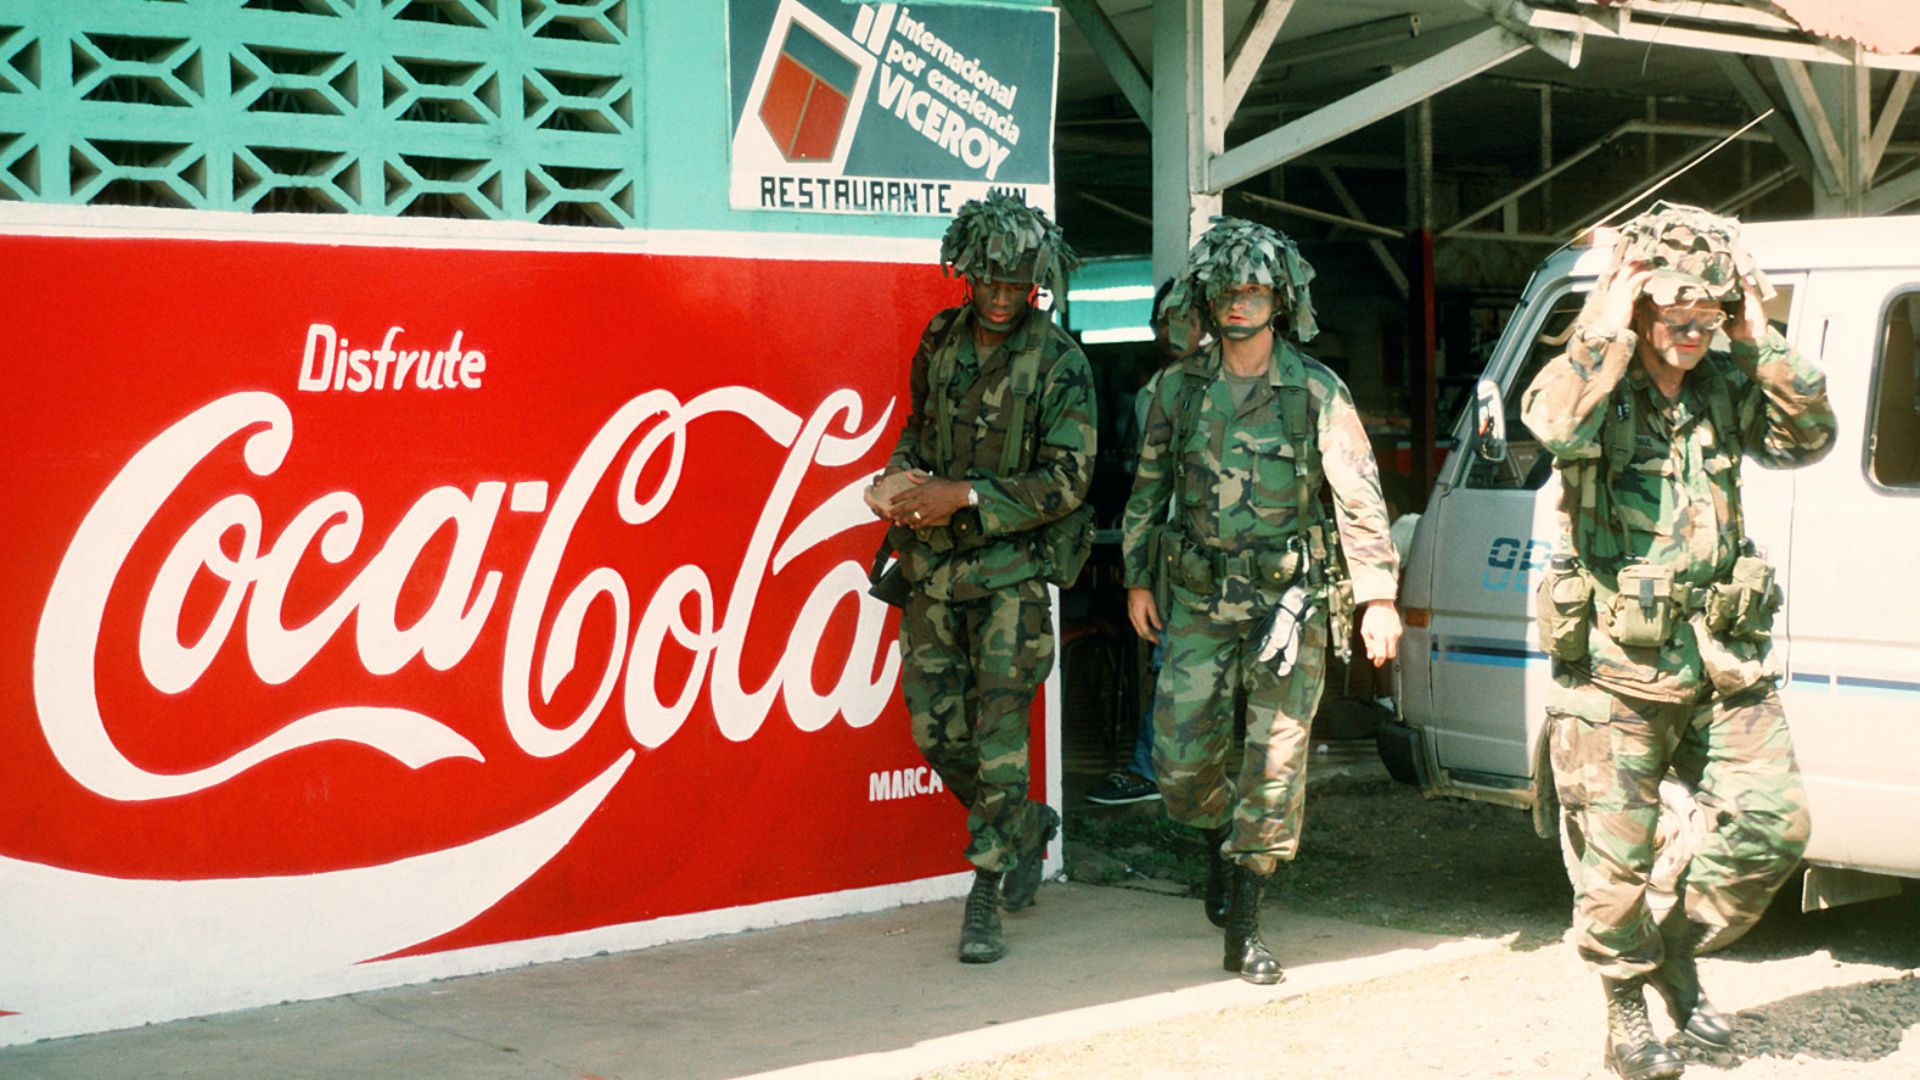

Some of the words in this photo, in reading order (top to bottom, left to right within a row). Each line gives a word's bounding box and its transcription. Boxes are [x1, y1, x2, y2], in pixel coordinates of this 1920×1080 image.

[885, 39, 926, 77] por
[927, 69, 1020, 145] excelencia
[896, 7, 1017, 110] internacional
[878, 63, 1010, 181] VICEROY
[761, 176, 952, 213] RESTAURANTE
[298, 324, 487, 393] Disfrute
[33, 388, 899, 800] Coca-Cola
[869, 766, 943, 802] MARCA
